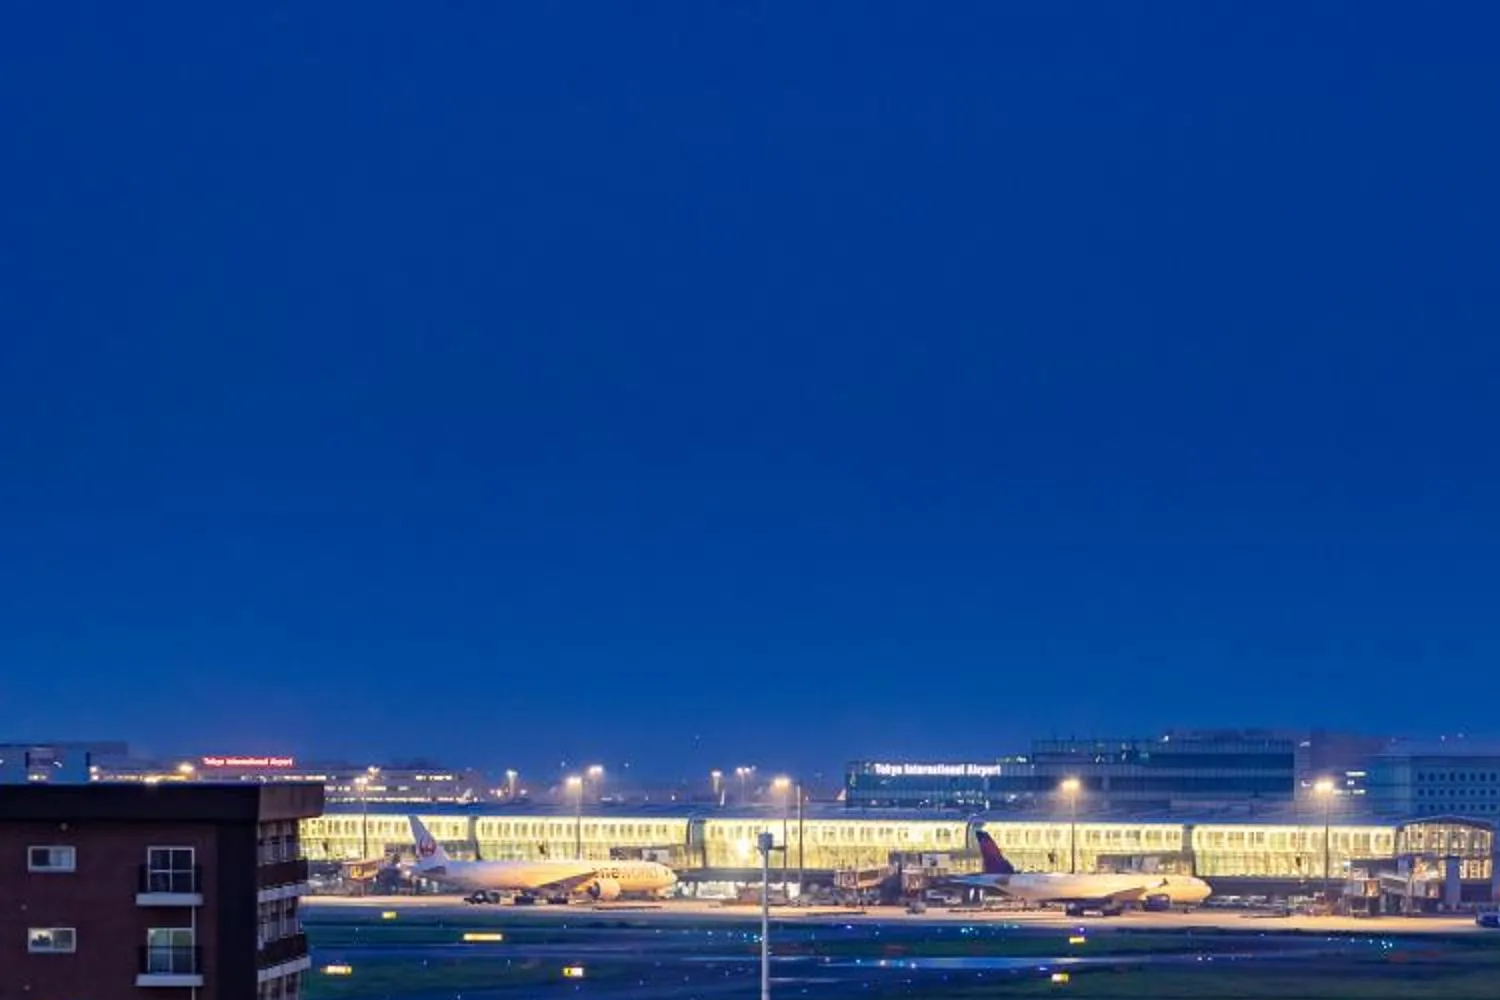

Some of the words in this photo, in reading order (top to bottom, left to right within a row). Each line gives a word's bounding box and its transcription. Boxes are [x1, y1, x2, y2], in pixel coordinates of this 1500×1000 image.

[874, 763, 902, 777] Tokyo
[904, 763, 965, 775] International
[967, 763, 1001, 777] Airport
